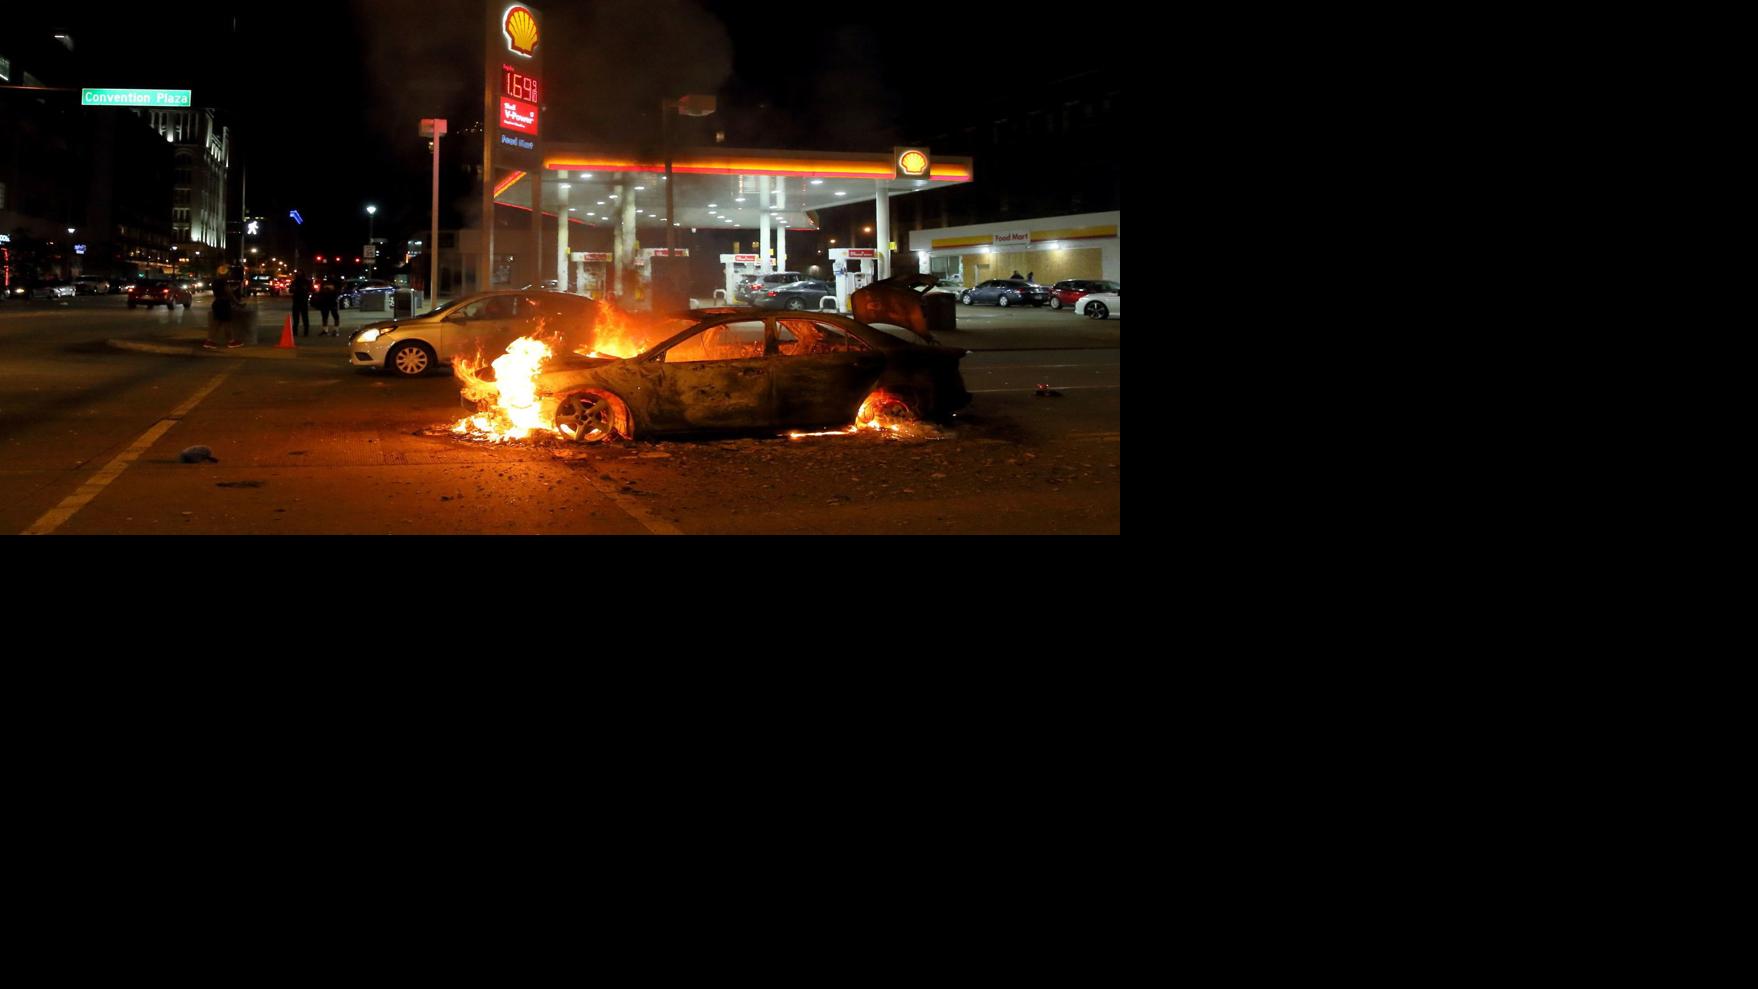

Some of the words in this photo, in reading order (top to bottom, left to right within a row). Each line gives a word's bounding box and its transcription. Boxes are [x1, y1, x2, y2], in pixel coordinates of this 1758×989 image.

[85, 91, 151, 103] Convention
[156, 92, 188, 104] Plaza
[994, 233, 1011, 242] Food
[1012, 232, 1028, 241] Mart
